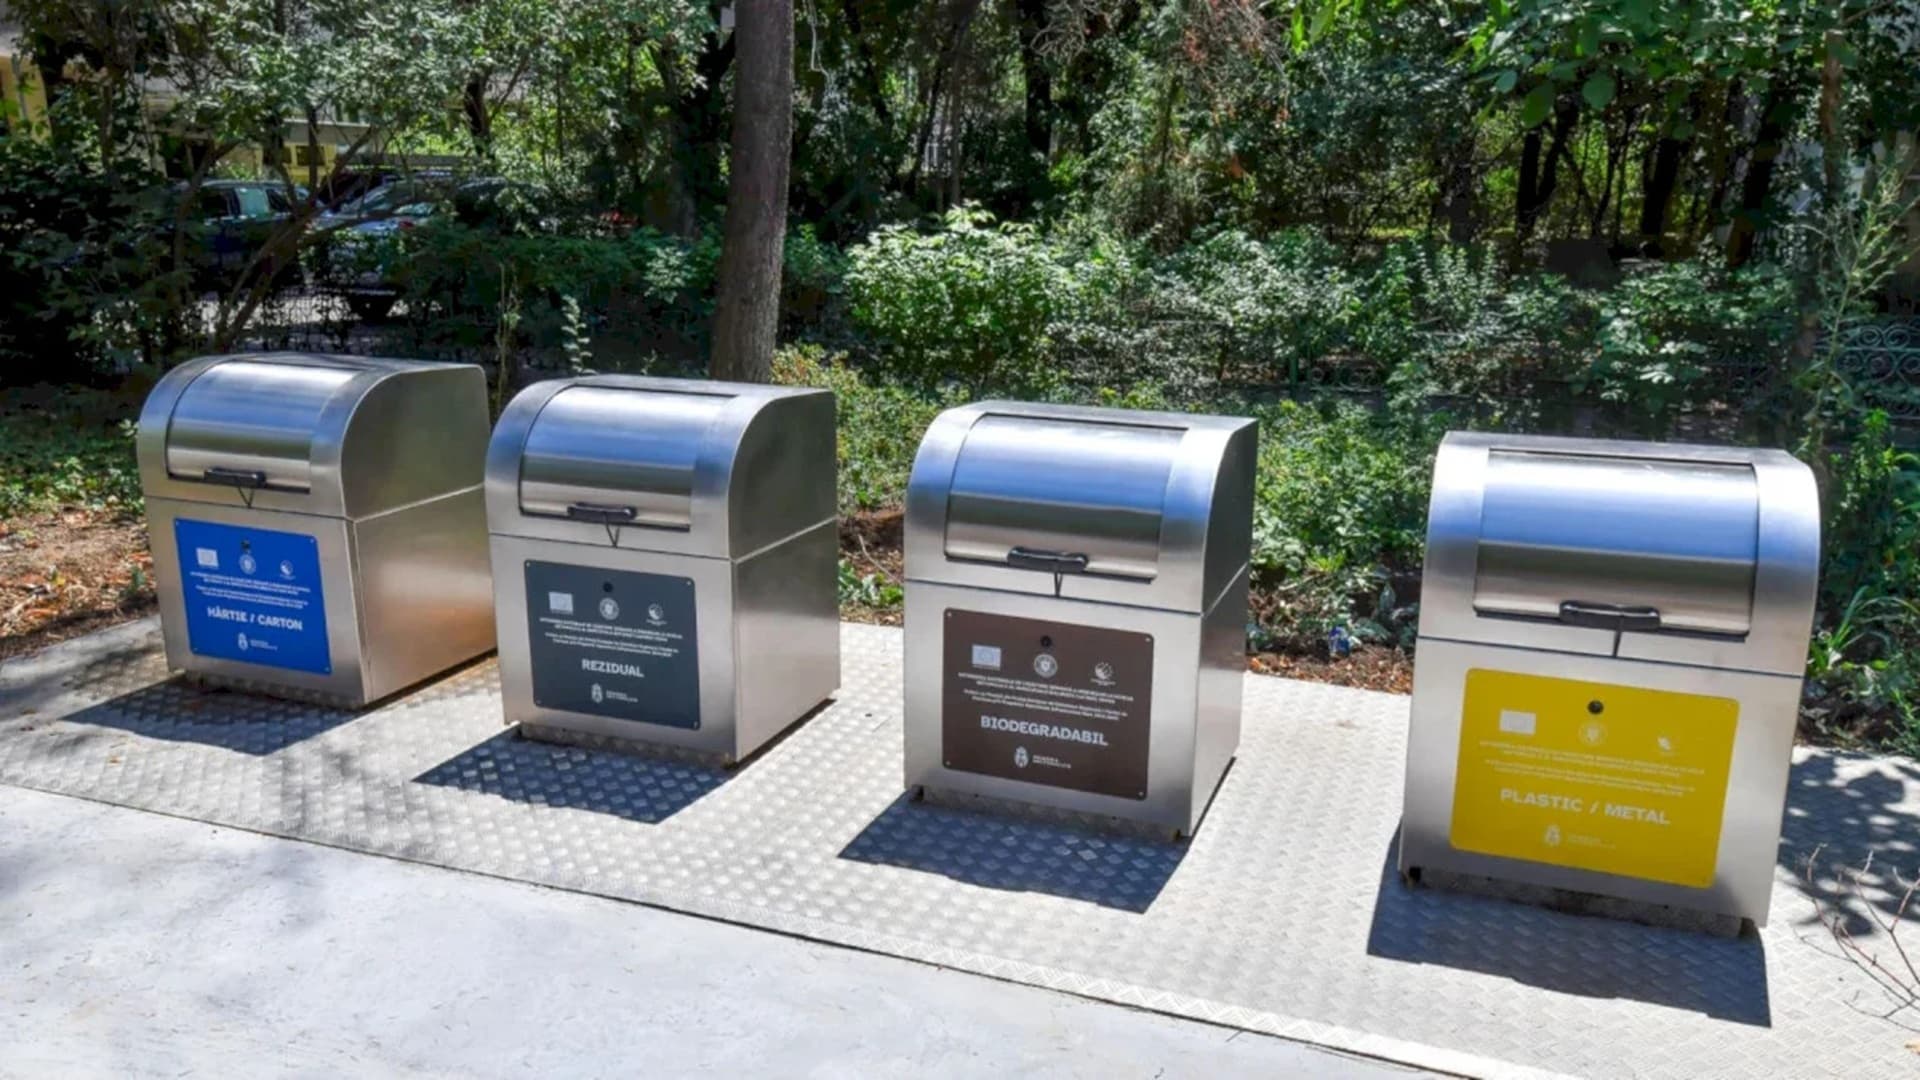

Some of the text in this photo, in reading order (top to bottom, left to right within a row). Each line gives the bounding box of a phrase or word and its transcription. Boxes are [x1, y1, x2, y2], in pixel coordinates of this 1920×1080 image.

[250, 613, 255, 623] /
[257, 613, 303, 631] CARTON
[581, 658, 645, 678] REZIDUAL
[980, 715, 1109, 746] BIODEGRADABIL
[1500, 788, 1671, 825] PLASTIC / METAL
